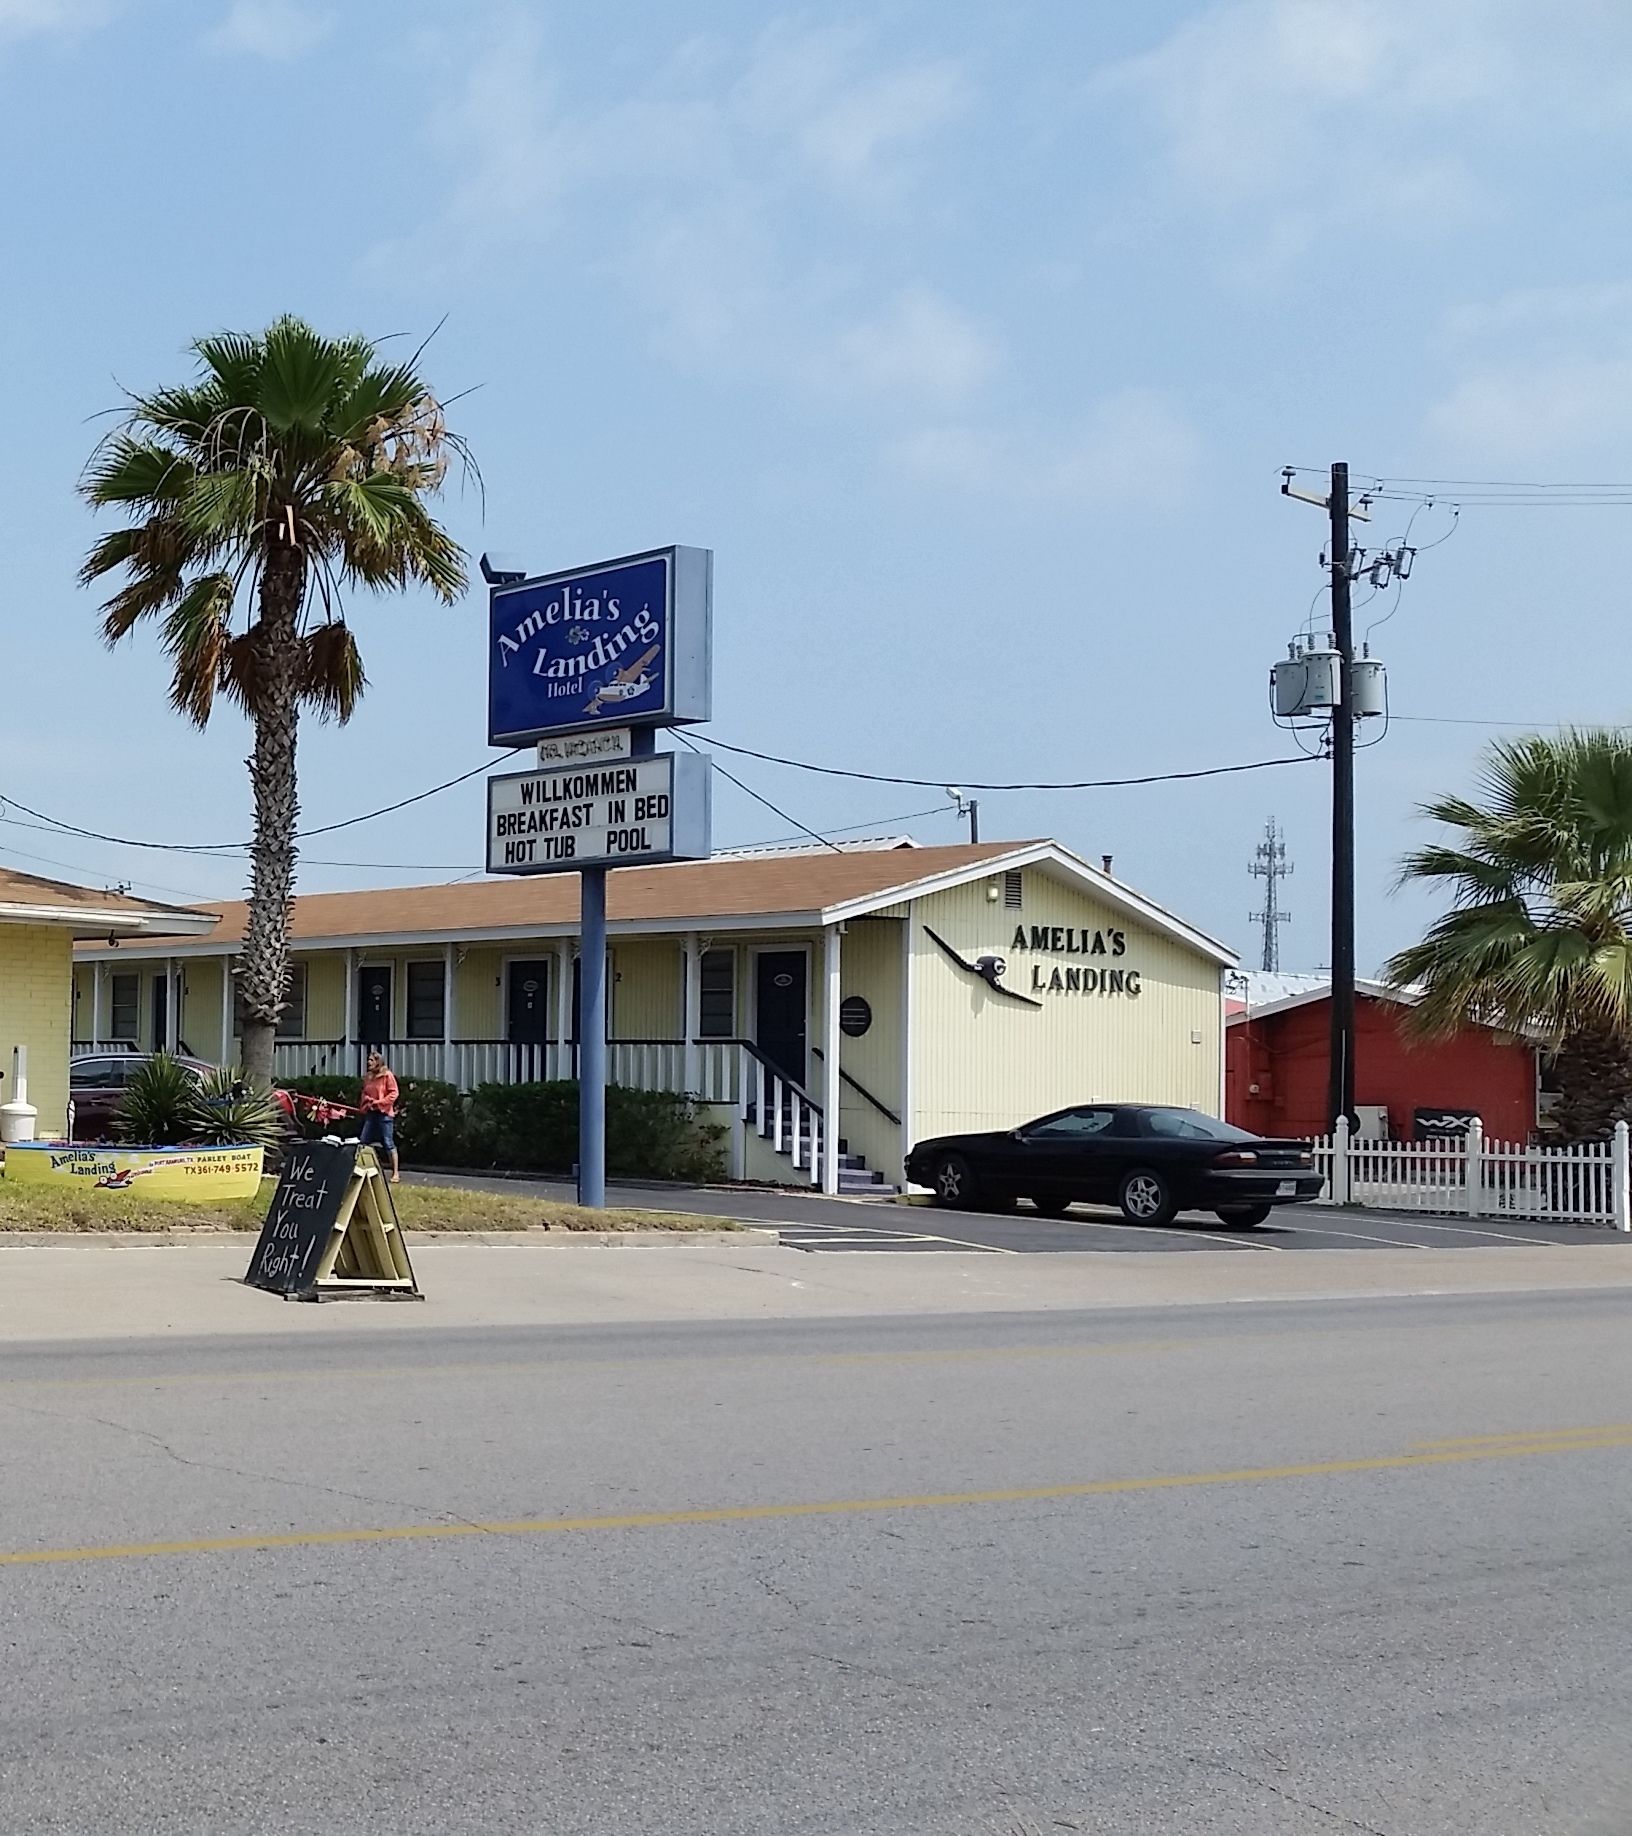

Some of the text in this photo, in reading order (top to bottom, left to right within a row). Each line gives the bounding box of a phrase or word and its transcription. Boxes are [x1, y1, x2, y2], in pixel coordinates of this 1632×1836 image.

[496, 585, 621, 669] Amelia's
[531, 601, 661, 679] Landing
[547, 676, 583, 699] Hotel
[520, 767, 638, 806] WILLKOMMEN
[496, 794, 669, 838] BREAKFAST IN BED
[504, 826, 652, 865] HOT TUB POOL
[1011, 924, 1127, 957] AMELIA'S
[1031, 964, 1142, 996] LANDING
[50, 1150, 97, 1169] Amelia's
[70, 1160, 117, 1176] Landing
[289, 1156, 315, 1182] We
[282, 1179, 329, 1210] Treat
[272, 1209, 300, 1240] You
